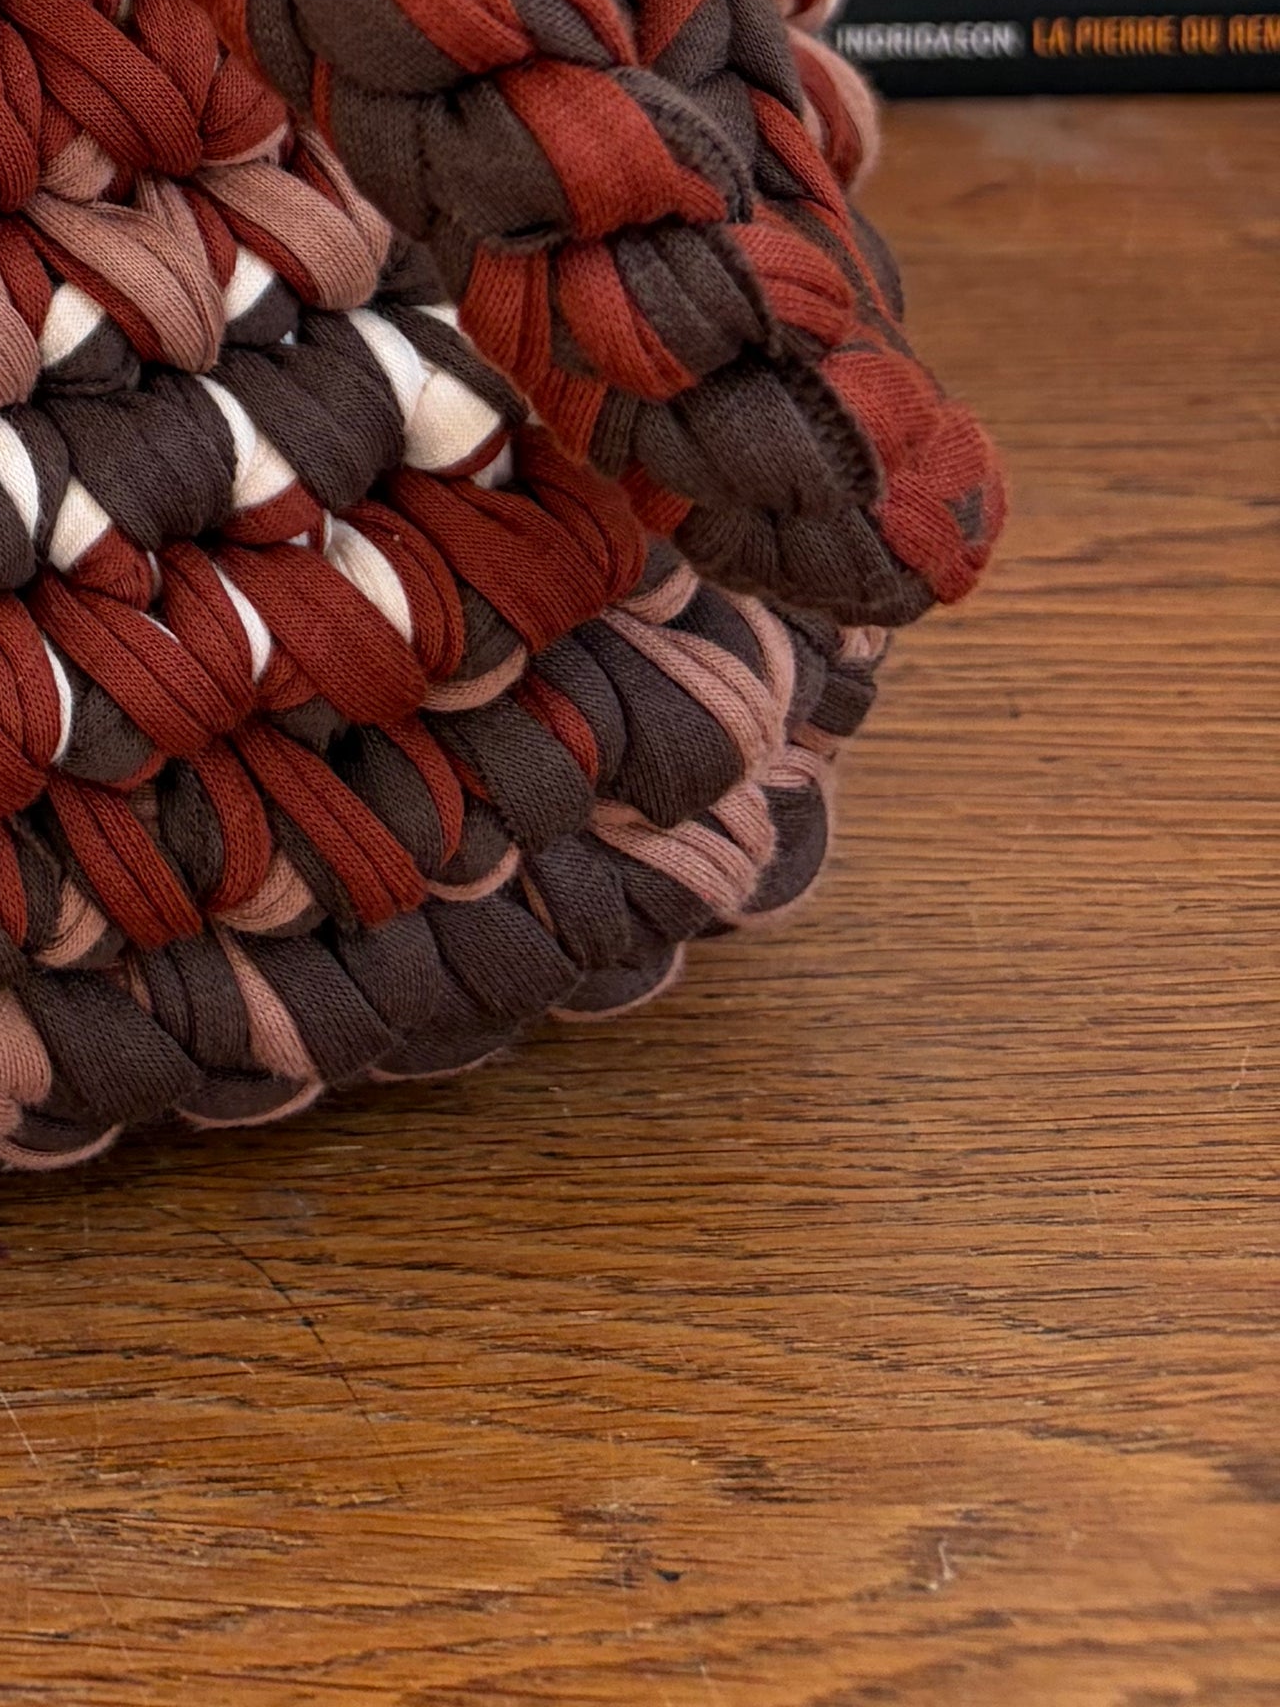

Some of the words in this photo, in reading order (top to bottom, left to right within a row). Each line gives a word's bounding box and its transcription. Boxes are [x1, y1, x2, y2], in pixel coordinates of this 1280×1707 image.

[1032, 16, 1072, 59] LA
[1075, 15, 1178, 58] PIERRE
[1181, 14, 1225, 58] DU
